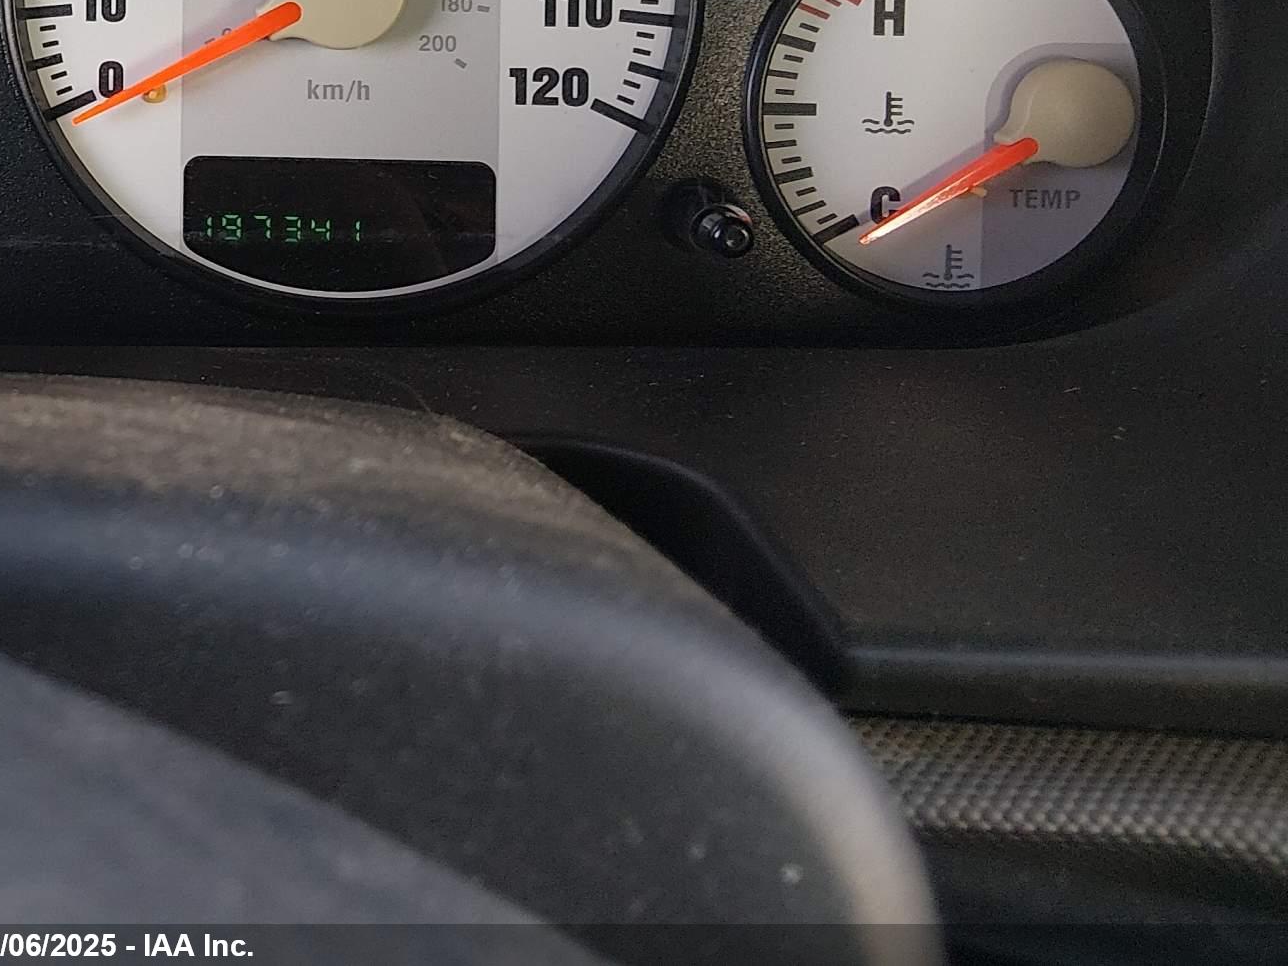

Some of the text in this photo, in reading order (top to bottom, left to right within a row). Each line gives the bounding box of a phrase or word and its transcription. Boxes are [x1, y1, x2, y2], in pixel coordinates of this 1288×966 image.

[418, 35, 457, 53] 200
[98, 60, 124, 99] 0
[306, 79, 371, 103] km/h
[508, 67, 590, 107] 120
[870, 185, 901, 225] C
[1008, 189, 1081, 210] TEMP
[206, 214, 361, 243] 197341
